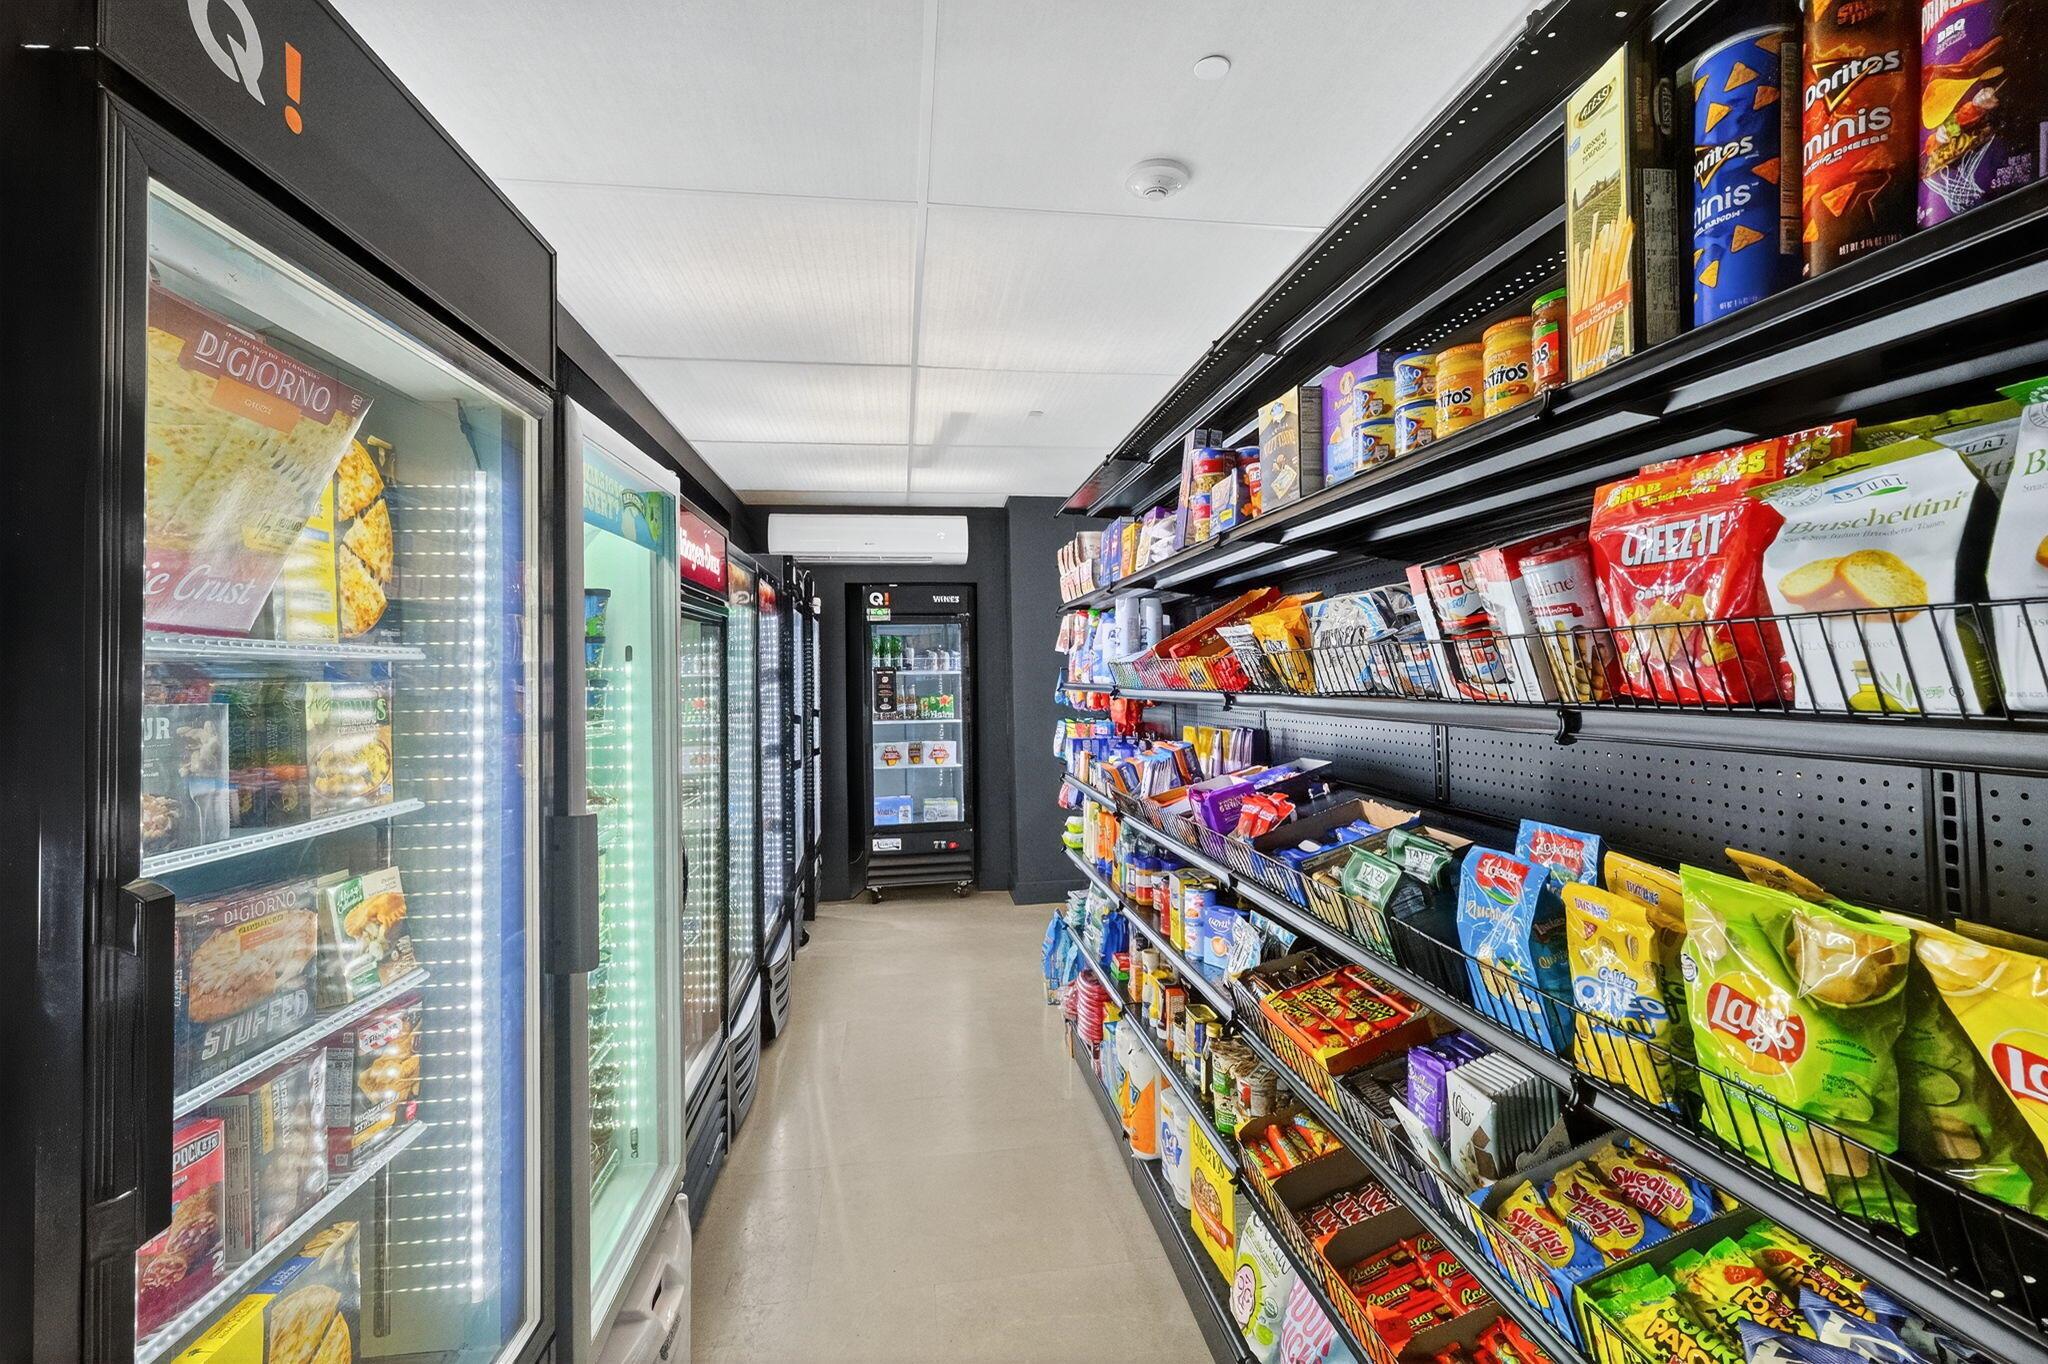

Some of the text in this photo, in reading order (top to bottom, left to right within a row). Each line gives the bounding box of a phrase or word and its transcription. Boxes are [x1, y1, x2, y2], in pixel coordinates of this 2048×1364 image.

[1805, 50, 1900, 112] Doritos
[1803, 106, 1893, 167] minis
[195, 330, 331, 412] DIGIORNO
[1831, 475, 1905, 502] ASTURI
[1785, 491, 1963, 537] Bruschettini
[173, 564, 257, 606] Crust
[869, 591, 891, 607] Q!
[932, 595, 960, 604] WINES
[223, 890, 297, 926] DIGIORNO
[202, 989, 309, 1061] STUFFED
[173, 1132, 220, 1168] POCKETS
[1562, 1181, 1641, 1239] Swedish
[1610, 1165, 1689, 1211] Swedish
[1621, 1184, 1668, 1217] Fish
[1502, 1207, 1570, 1260] Swedish
[1569, 1203, 1613, 1237] Fish
